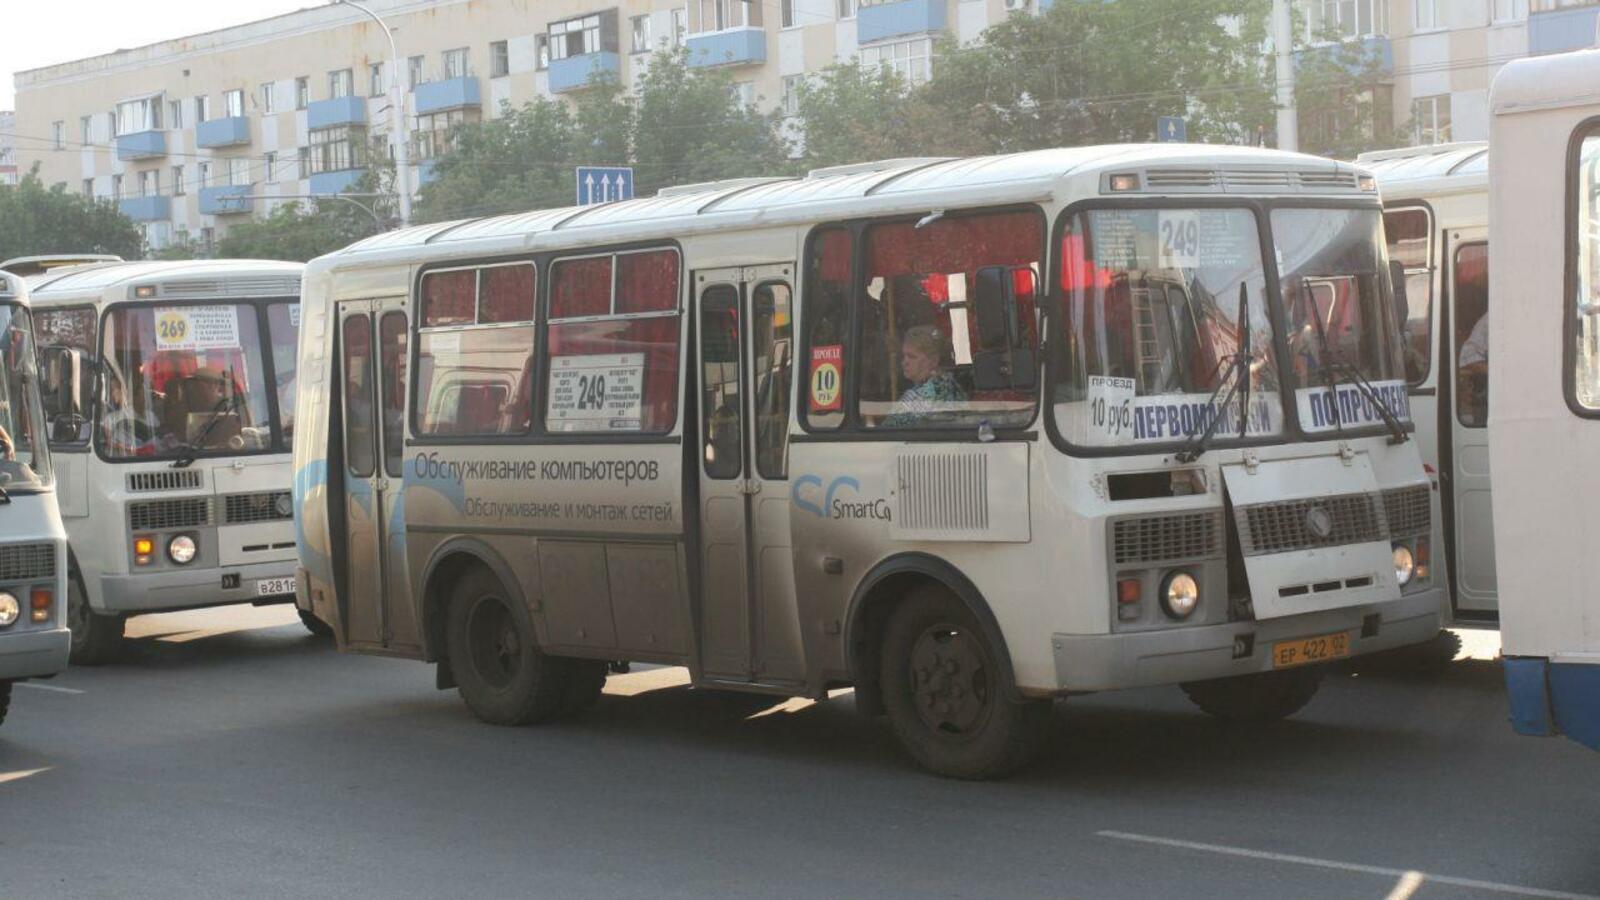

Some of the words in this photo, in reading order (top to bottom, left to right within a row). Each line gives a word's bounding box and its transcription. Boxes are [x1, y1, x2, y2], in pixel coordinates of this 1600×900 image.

[1161, 219, 1198, 257] 249
[159, 320, 186, 339] 269
[578, 374, 605, 410] 249
[817, 370, 834, 390] 10
[1091, 377, 1133, 390] ПРОЕЗД
[1091, 396, 1105, 427] 10
[1108, 397, 1133, 435] руб.
[1133, 399, 1270, 438] ПЕРВОМАЙСОЙ
[1308, 390, 1338, 427] ПО
[414, 452, 536, 485] Обслуживание
[541, 460, 659, 487] компьютеров
[464, 496, 560, 519] Обслуживание
[565, 502, 574, 517] и
[576, 501, 628, 521] монтаж
[632, 501, 672, 521] сетей
[1280, 647, 1297, 665] ЕР
[1303, 638, 1328, 660] 422
